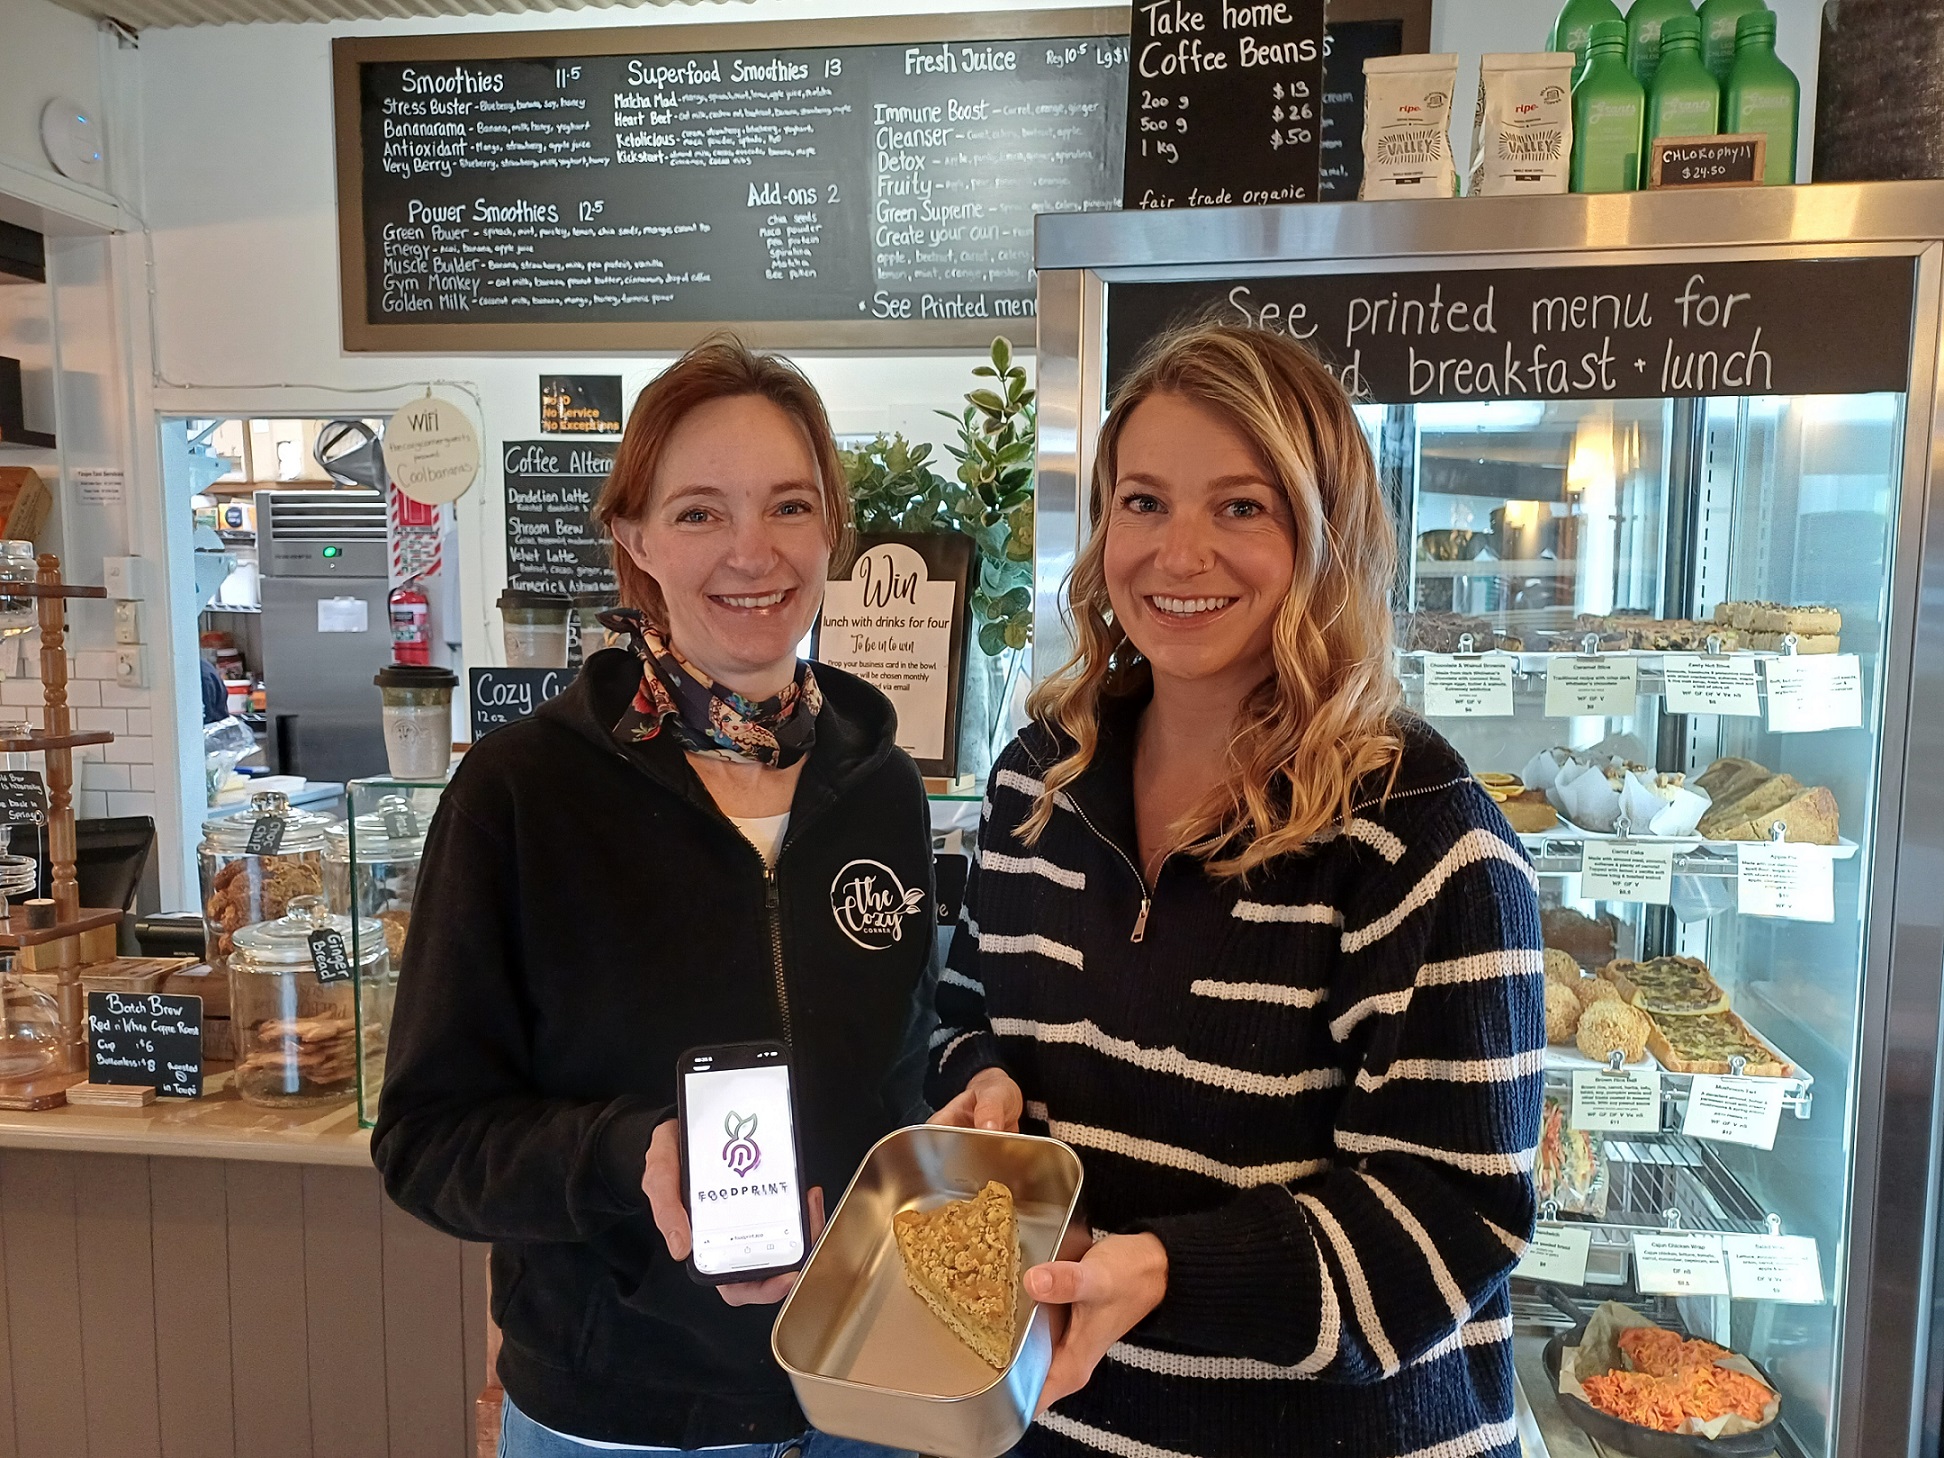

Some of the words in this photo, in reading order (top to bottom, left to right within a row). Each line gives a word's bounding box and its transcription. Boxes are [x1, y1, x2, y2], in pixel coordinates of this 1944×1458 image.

[1140, 0, 1205, 36] Take
[1222, 0, 1293, 30] home
[904, 43, 958, 75] Fresh
[961, 47, 1017, 72] Juice
[1139, 39, 1228, 78] Coffee
[1239, 36, 1317, 68] Beans
[401, 66, 504, 94] Smoothies
[556, 66, 581, 88] 11.5
[627, 59, 722, 89] Superfood
[730, 59, 809, 83] Smoothies
[824, 58, 842, 79] 13
[382, 98, 427, 116] Stress
[429, 99, 473, 116] Buster
[614, 92, 651, 110] Matcha
[653, 91, 679, 108] Mad
[1399, 105, 1421, 113] ripe
[1515, 104, 1538, 114] ripe
[614, 111, 645, 127] Heart
[873, 103, 942, 125] Immune
[947, 99, 991, 121] Boost
[384, 118, 466, 138] Bananarama
[876, 126, 954, 150] Cleanser
[383, 137, 468, 157] Antioxidant
[615, 131, 677, 149] Ketolicious
[1387, 139, 1432, 156] VALLEY
[1508, 140, 1553, 154] VALLEY
[616, 149, 665, 164] Kickstart
[877, 150, 926, 172] Detox
[382, 157, 411, 179] Very
[414, 158, 452, 178] Berry
[747, 182, 818, 207] Add-ons
[827, 184, 841, 204] 2
[877, 171, 932, 200] Fruity
[1139, 189, 1175, 210] fair
[1188, 187, 1233, 207] trade
[1243, 184, 1306, 206] organic
[408, 198, 466, 224] Power
[472, 197, 560, 223] Smoothies
[579, 200, 605, 222] 12.5
[876, 199, 918, 224] Green
[920, 199, 985, 227] Supreme
[382, 222, 424, 241] Green
[431, 224, 469, 240] Power
[876, 224, 924, 247] Create
[928, 226, 967, 247] your
[969, 225, 1000, 241] own
[383, 242, 431, 261] Energy
[383, 258, 428, 275] Muscle
[433, 256, 480, 273] Builder
[383, 275, 420, 295] Gym
[428, 274, 480, 298] Monkey
[382, 291, 433, 312] Golden
[439, 293, 470, 311] Milk
[871, 290, 912, 320] See
[921, 293, 989, 319] Printed
[1218, 286, 1318, 339] See
[1346, 283, 1497, 347] printed
[1532, 292, 1652, 333] menu
[1674, 273, 1751, 328] for
[1409, 336, 1617, 396] breakfast
[1660, 326, 1772, 392] lunch
[505, 445, 560, 474] Coffee
[508, 487, 558, 504] Dandelion
[561, 487, 591, 504] Latte
[508, 516, 550, 536] Shroom
[555, 518, 584, 535] Brew
[509, 546, 541, 562] Velvet
[546, 549, 579, 564] Latte
[859, 555, 918, 608] Win
[823, 616, 848, 627] lunch
[851, 616, 872, 627] with
[875, 616, 906, 628] drinks
[909, 616, 925, 628] for
[927, 617, 950, 629] four
[850, 633, 864, 654] To
[864, 637, 877, 653] be
[878, 640, 887, 653] in
[888, 636, 897, 651] to
[898, 640, 915, 654] win
[843, 661, 858, 669] your
[859, 660, 884, 669] business
[885, 661, 899, 669] card
[900, 661, 907, 669] in
[907, 661, 919, 669] the
[880, 672, 902, 680] chosen
[903, 672, 929, 682] monthly
[476, 672, 533, 715] Cozy
[326, 933, 351, 979] Ginger
[106, 993, 147, 1015] Batch
[147, 995, 183, 1016] Brew
[89, 1015, 110, 1033] Red
[122, 1017, 147, 1033] White
[97, 1039, 116, 1052] Cup
[698, 1182, 789, 1202] FOODPRINT
